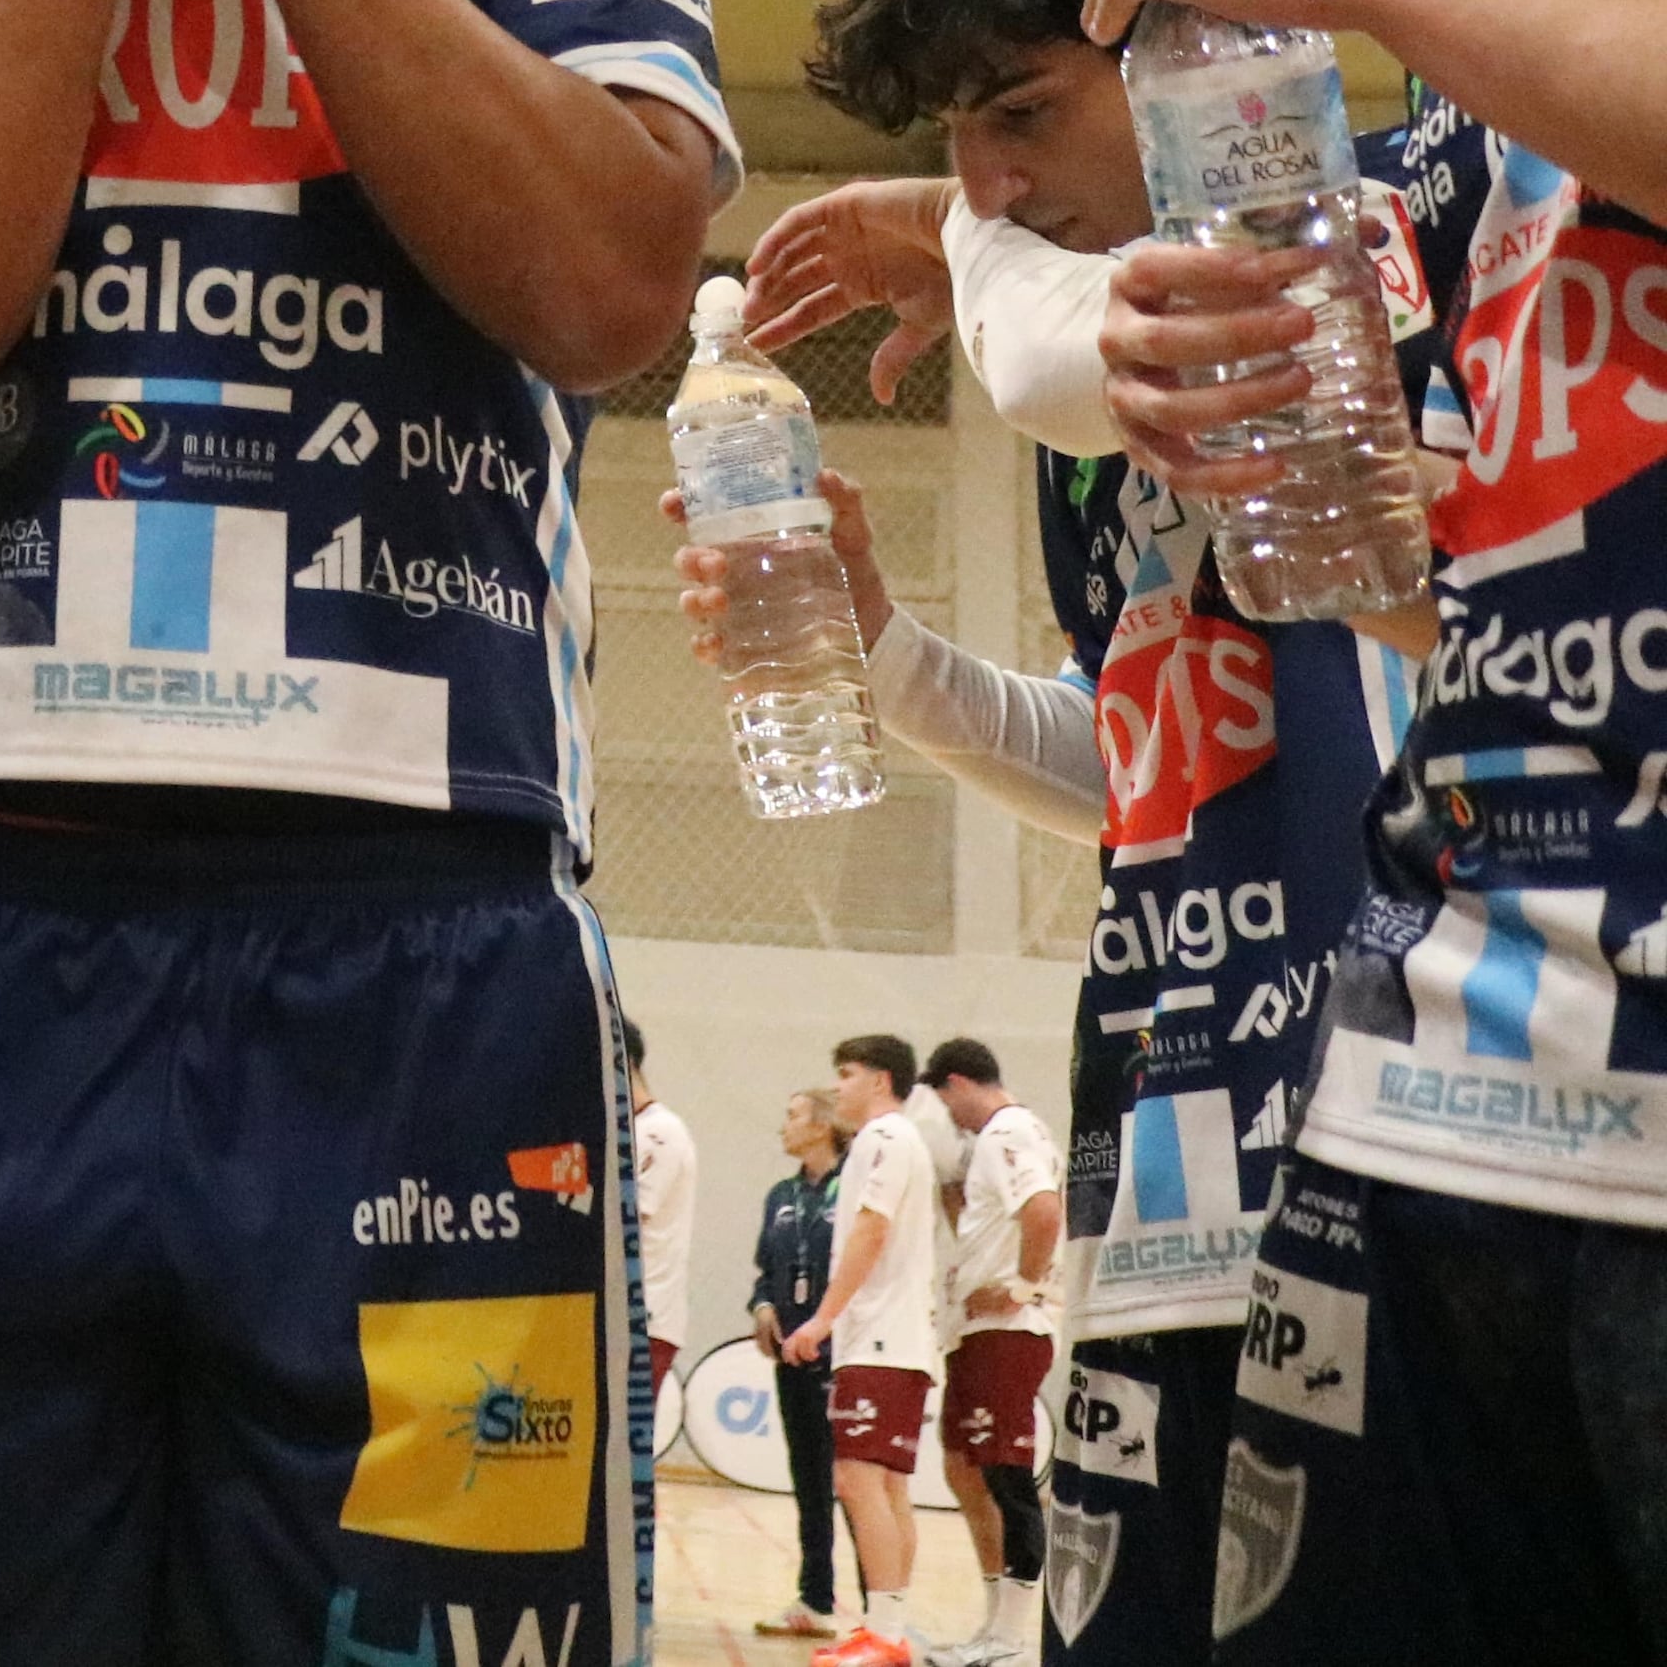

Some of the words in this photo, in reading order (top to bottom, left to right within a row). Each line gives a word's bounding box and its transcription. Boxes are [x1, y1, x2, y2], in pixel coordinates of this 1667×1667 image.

[1202, 167, 1248, 190] DEL
[1251, 151, 1321, 182] ROSAL
[1227, 130, 1297, 160] AGUA
[1467, 213, 1550, 282] CATE
[399, 414, 537, 509] plytix
[366, 538, 537, 632] Agebán
[352, 1177, 521, 1246] enPie.es
[1246, 1301, 1306, 1372] RP
[478, 1393, 572, 1445] Sixto
